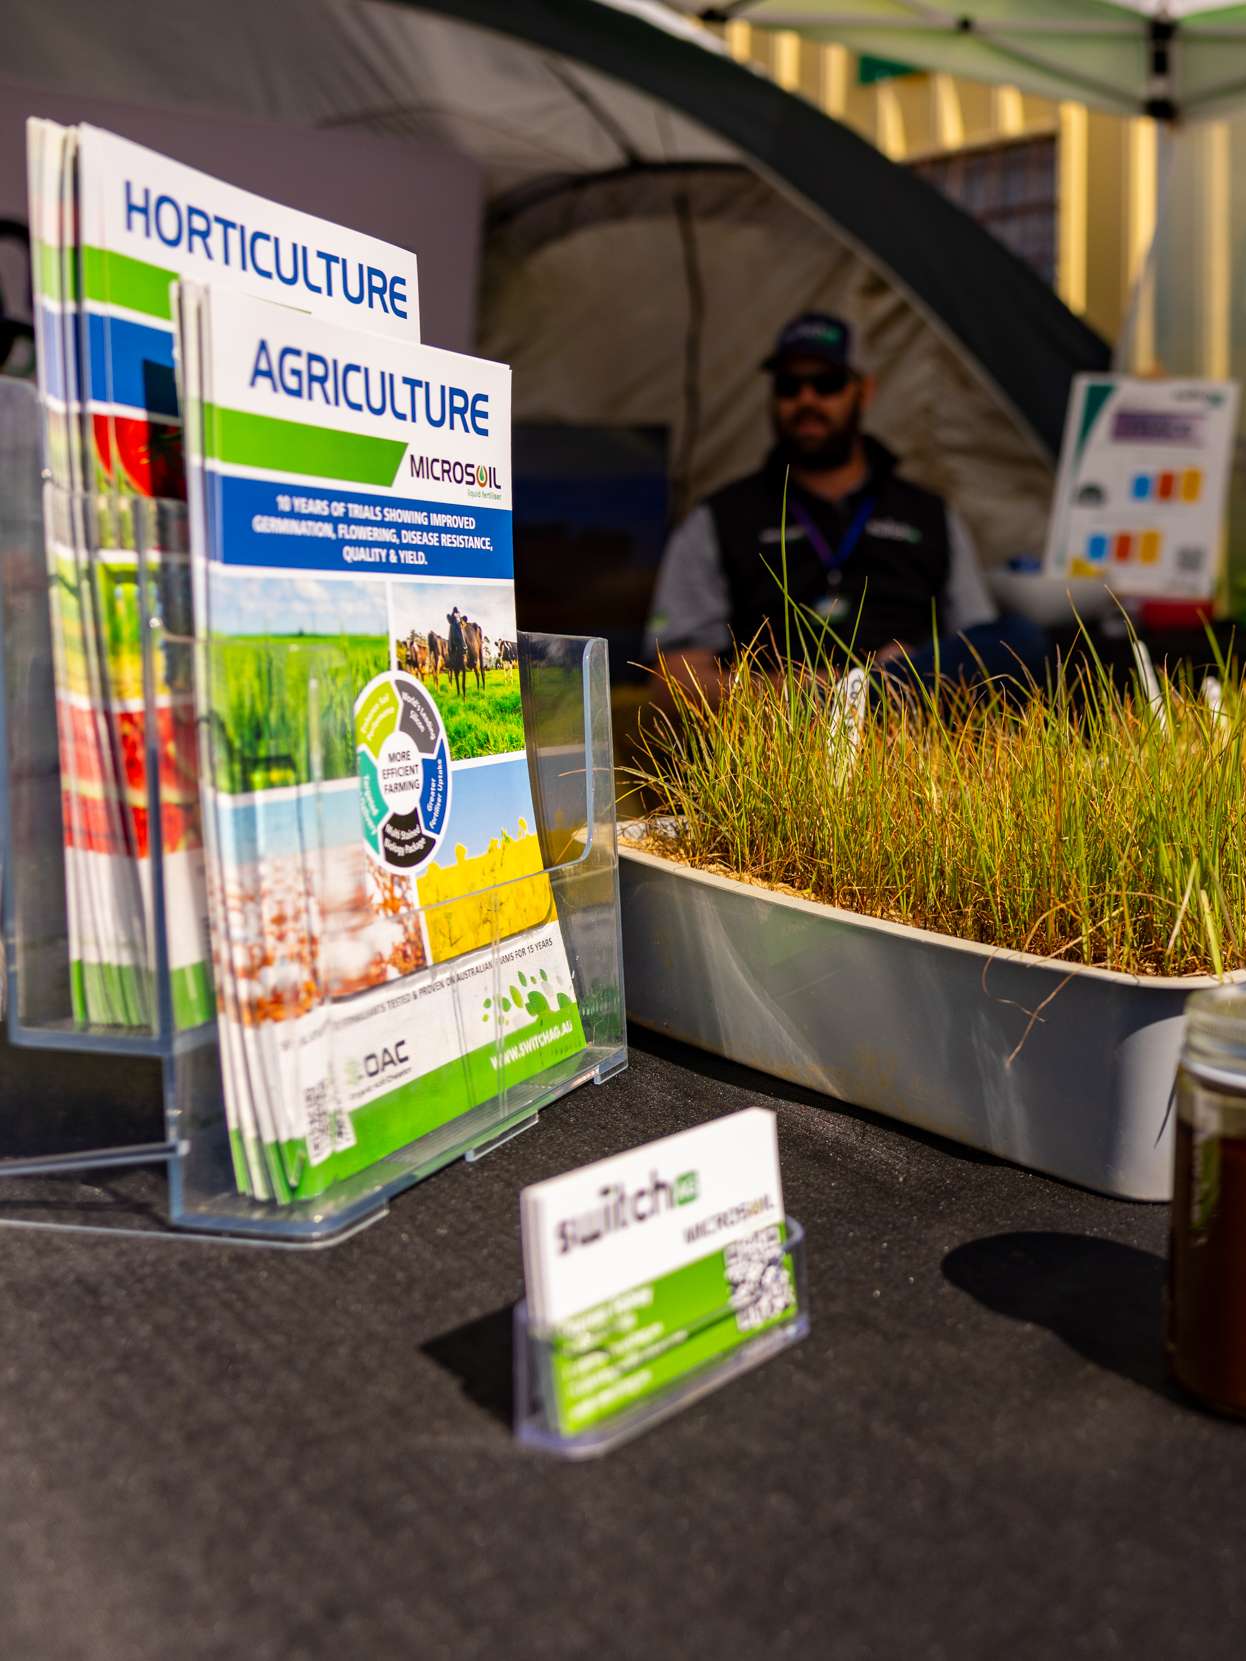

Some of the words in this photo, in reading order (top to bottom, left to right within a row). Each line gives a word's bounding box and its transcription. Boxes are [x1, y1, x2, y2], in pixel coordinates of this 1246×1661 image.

[124, 179, 408, 320] HORTICULTURE
[249, 339, 490, 437] AGRICULTURE
[410, 453, 502, 489] MICROSOIL
[293, 496, 329, 516] YEARS
[331, 502, 346, 517] OF
[347, 504, 382, 521] TRIALS
[383, 508, 428, 525] SHOWING
[430, 513, 476, 530] IMPROVED
[252, 515, 337, 540] GERMINATION,
[338, 524, 400, 545] FLOWERING,
[401, 529, 440, 547] DISEASE
[441, 533, 493, 552] RESISTANCE,
[342, 546, 387, 563] QUALITY
[389, 550, 398, 564] &
[399, 551, 429, 565] YIELD.
[382, 764, 420, 780] EFFICIENT
[388, 750, 411, 762] MORE
[384, 778, 420, 795] FARMING
[437, 758, 445, 791] Uptake
[426, 777, 436, 812] Greater
[419, 981, 446, 997] PROVEN
[456, 961, 494, 983] AUSTRALIAN
[515, 947, 526, 960] FOR
[527, 944, 534, 955] 15
[534, 938, 553, 952] YEARS
[363, 1039, 409, 1078] OAC
[555, 1168, 675, 1255] switch
